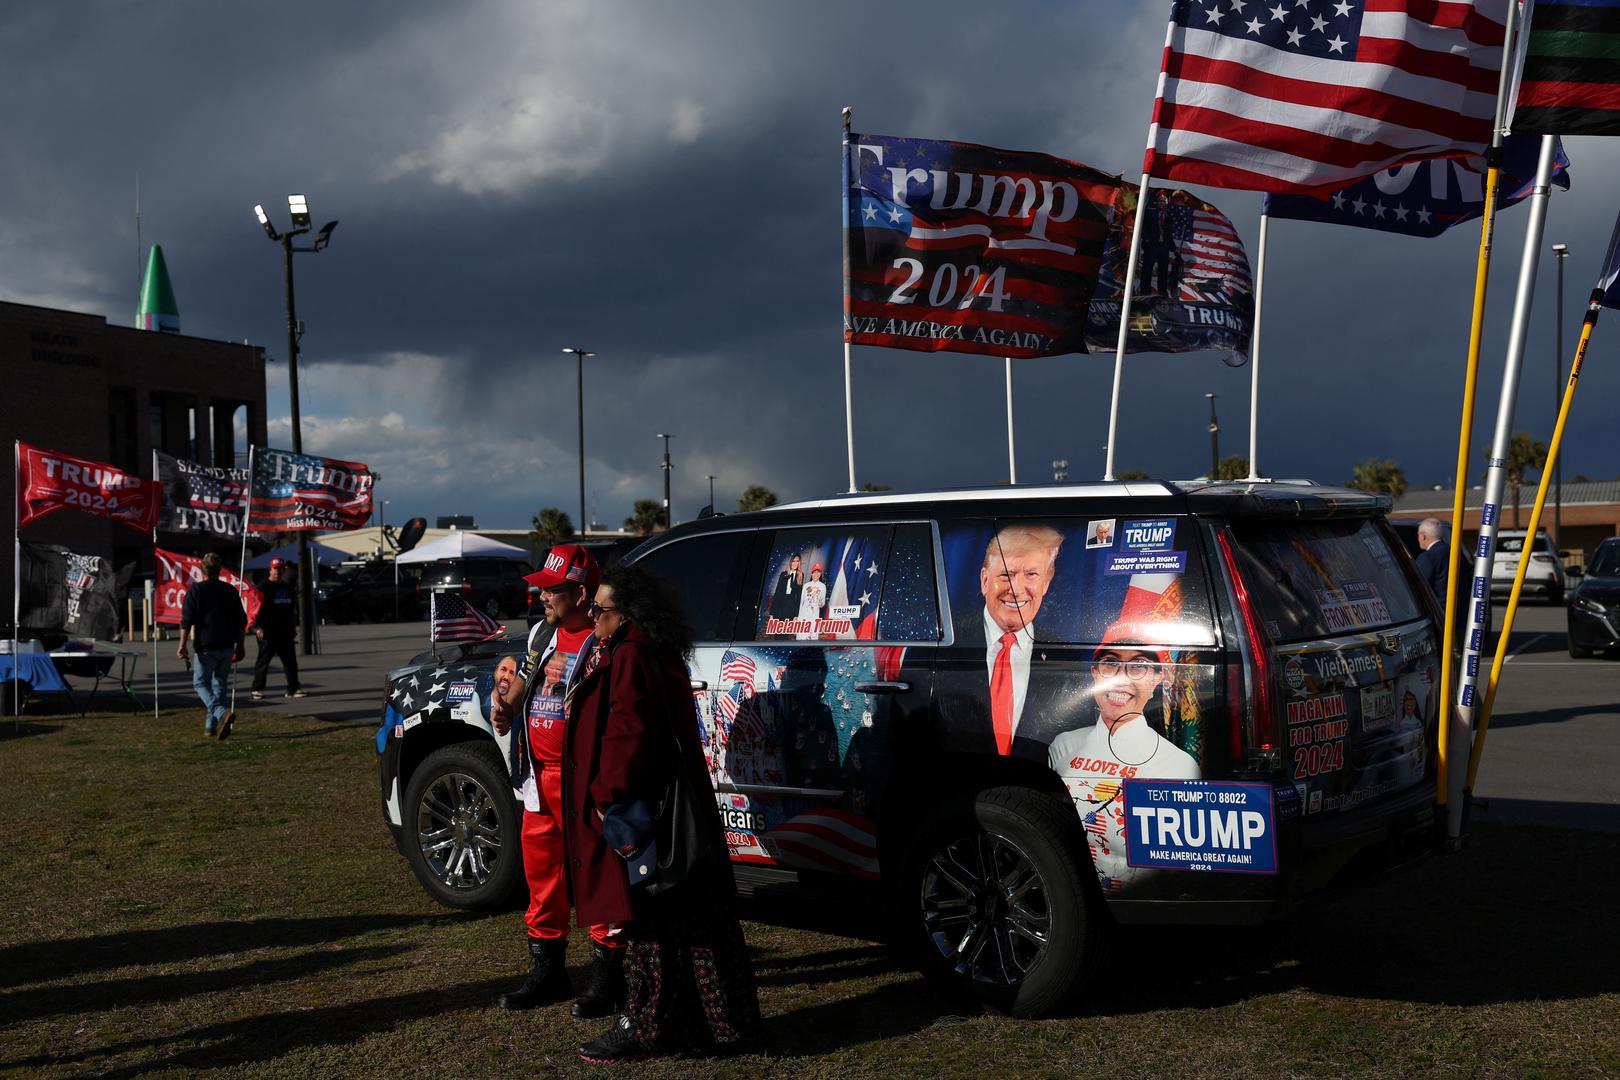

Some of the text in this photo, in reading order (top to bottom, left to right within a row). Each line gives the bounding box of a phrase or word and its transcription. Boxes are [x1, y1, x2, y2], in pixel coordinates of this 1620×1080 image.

[849, 143, 1080, 241] Trump
[886, 257, 1012, 313] 2024
[41, 456, 142, 491] TRUMP
[176, 458, 226, 480] STAND
[265, 452, 373, 500] Trump
[63, 488, 119, 511] 2024
[294, 501, 338, 520] 2024
[176, 505, 260, 538] TRUM
[286, 517, 345, 530] Miss Me Yet?
[1125, 527, 1172, 543] TRUMP
[160, 556, 250, 592] MAA
[1135, 562, 1180, 570] EVERYTHING
[766, 617, 851, 634] Melania Trump
[1314, 654, 1384, 679] Vietnamese
[449, 686, 474, 697] TRUMP
[1287, 699, 1324, 724] MAGA
[530, 718, 554, 730] 45-47
[1290, 719, 1349, 747] FOR TRUMP
[1070, 757, 1138, 778] 45 LOVE 45
[1294, 740, 1344, 779] 2024
[1147, 790, 1247, 804] TEXT TRUMP TO 88022
[1132, 806, 1266, 850] TRUMP
[1150, 850, 1252, 865] MAKE AMERICA GREAT AGAIN!
[1190, 863, 1212, 871] 2024
